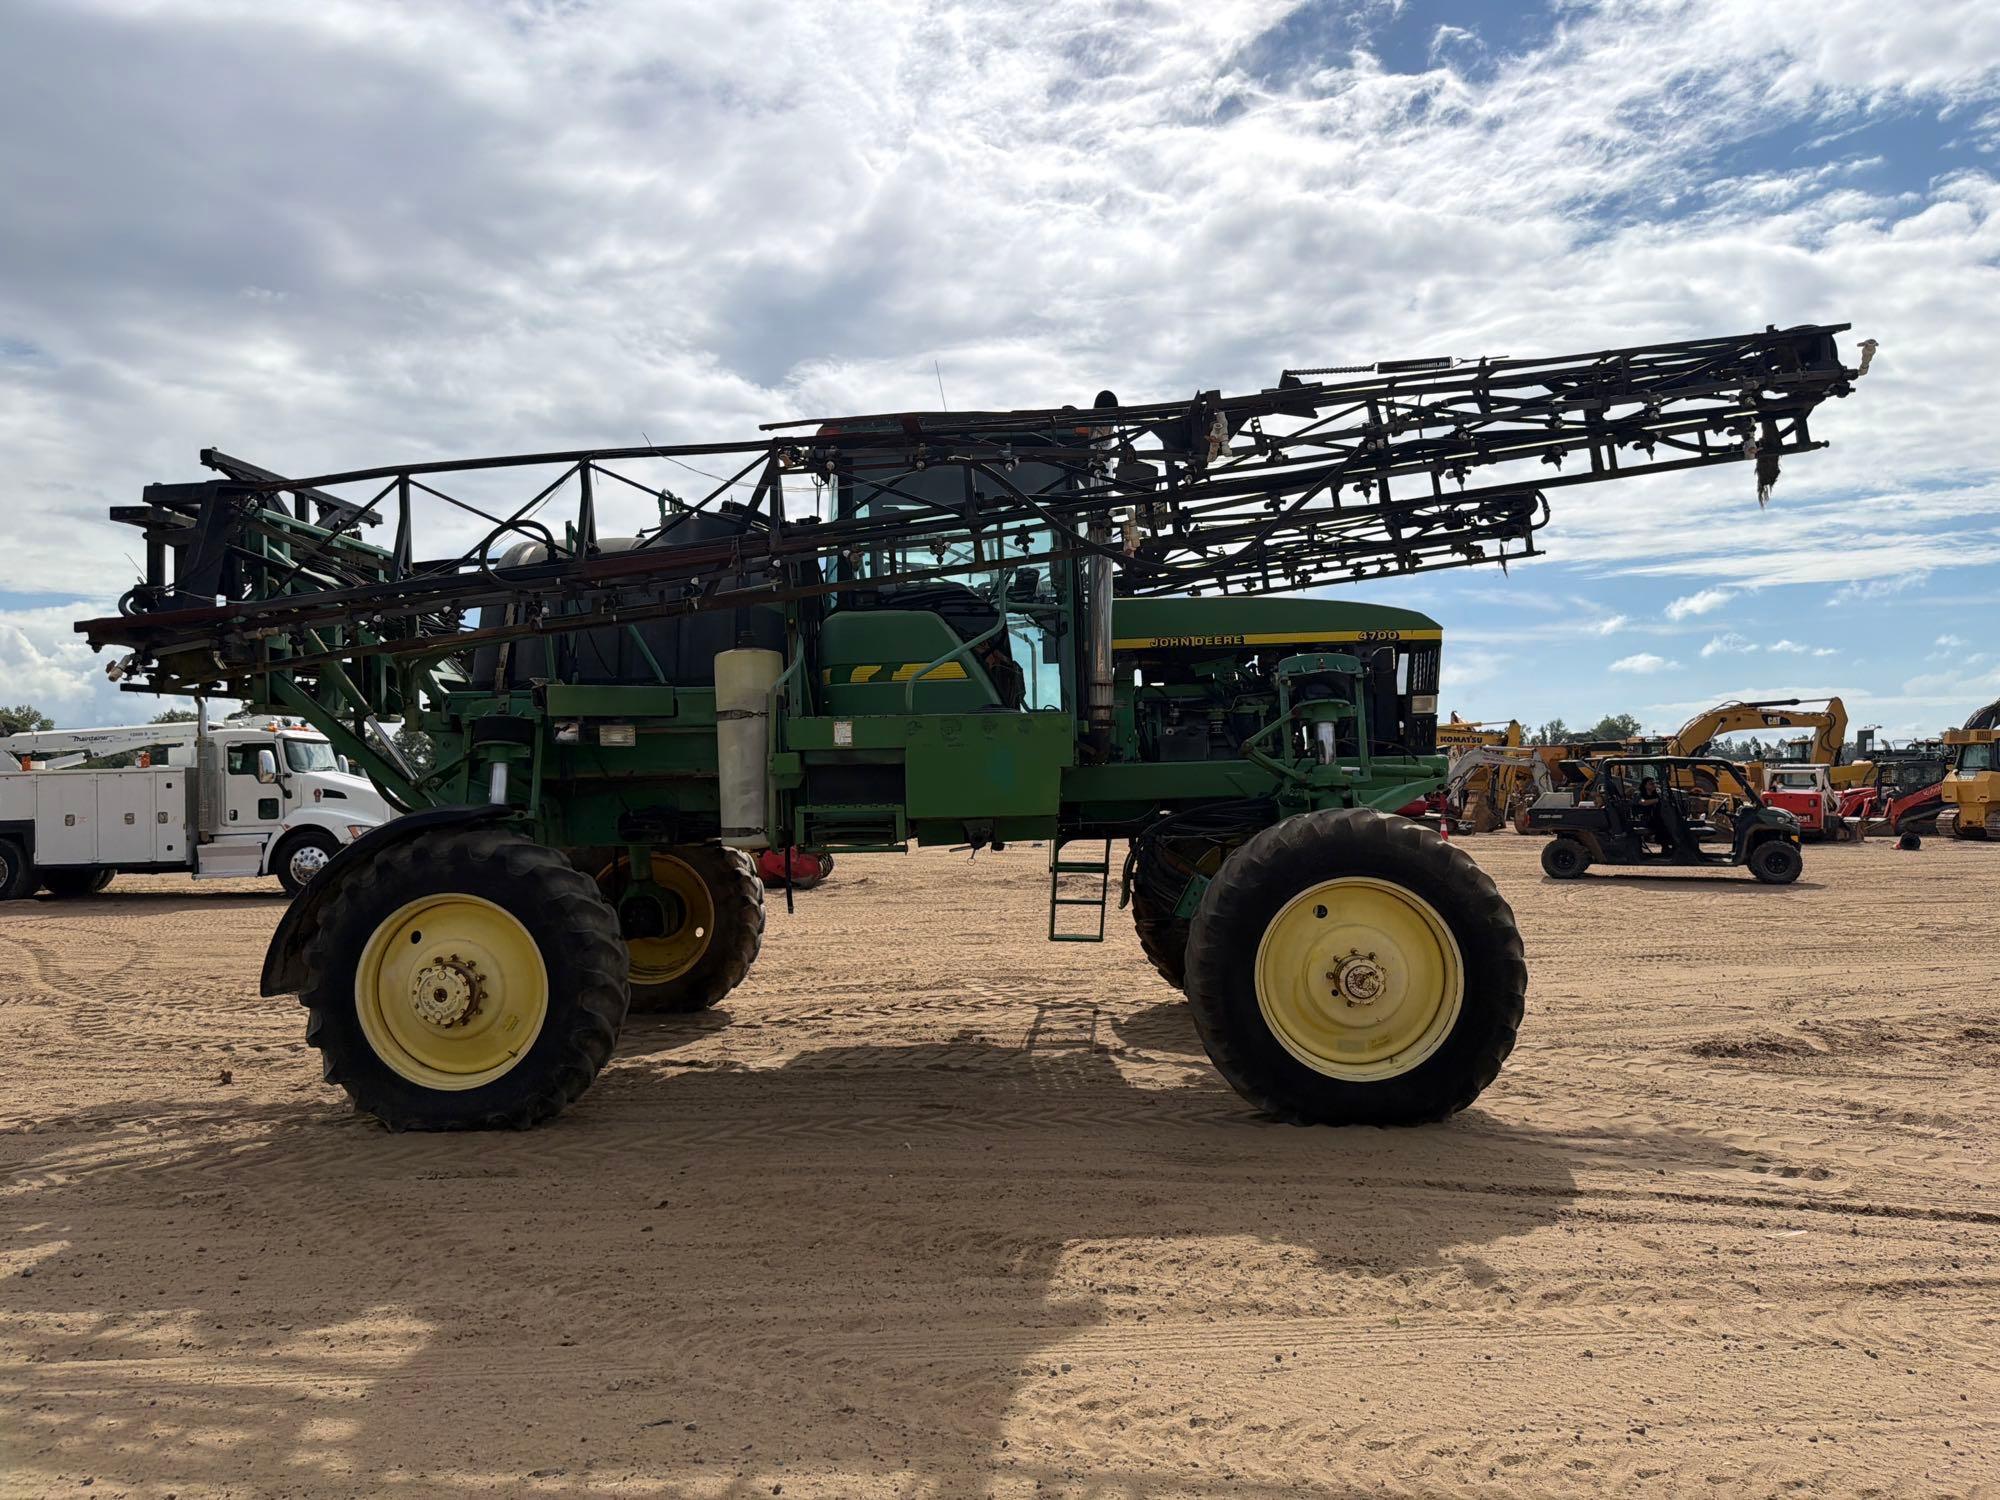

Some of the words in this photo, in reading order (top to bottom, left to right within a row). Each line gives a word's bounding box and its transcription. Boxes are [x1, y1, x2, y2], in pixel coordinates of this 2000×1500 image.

[1358, 631, 1398, 640] 4700
[1150, 637, 1191, 647] JOHN
[1195, 634, 1243, 646] DEERE
[1767, 716, 1781, 726] CAT
[1440, 735, 1483, 744] KOMATSU
